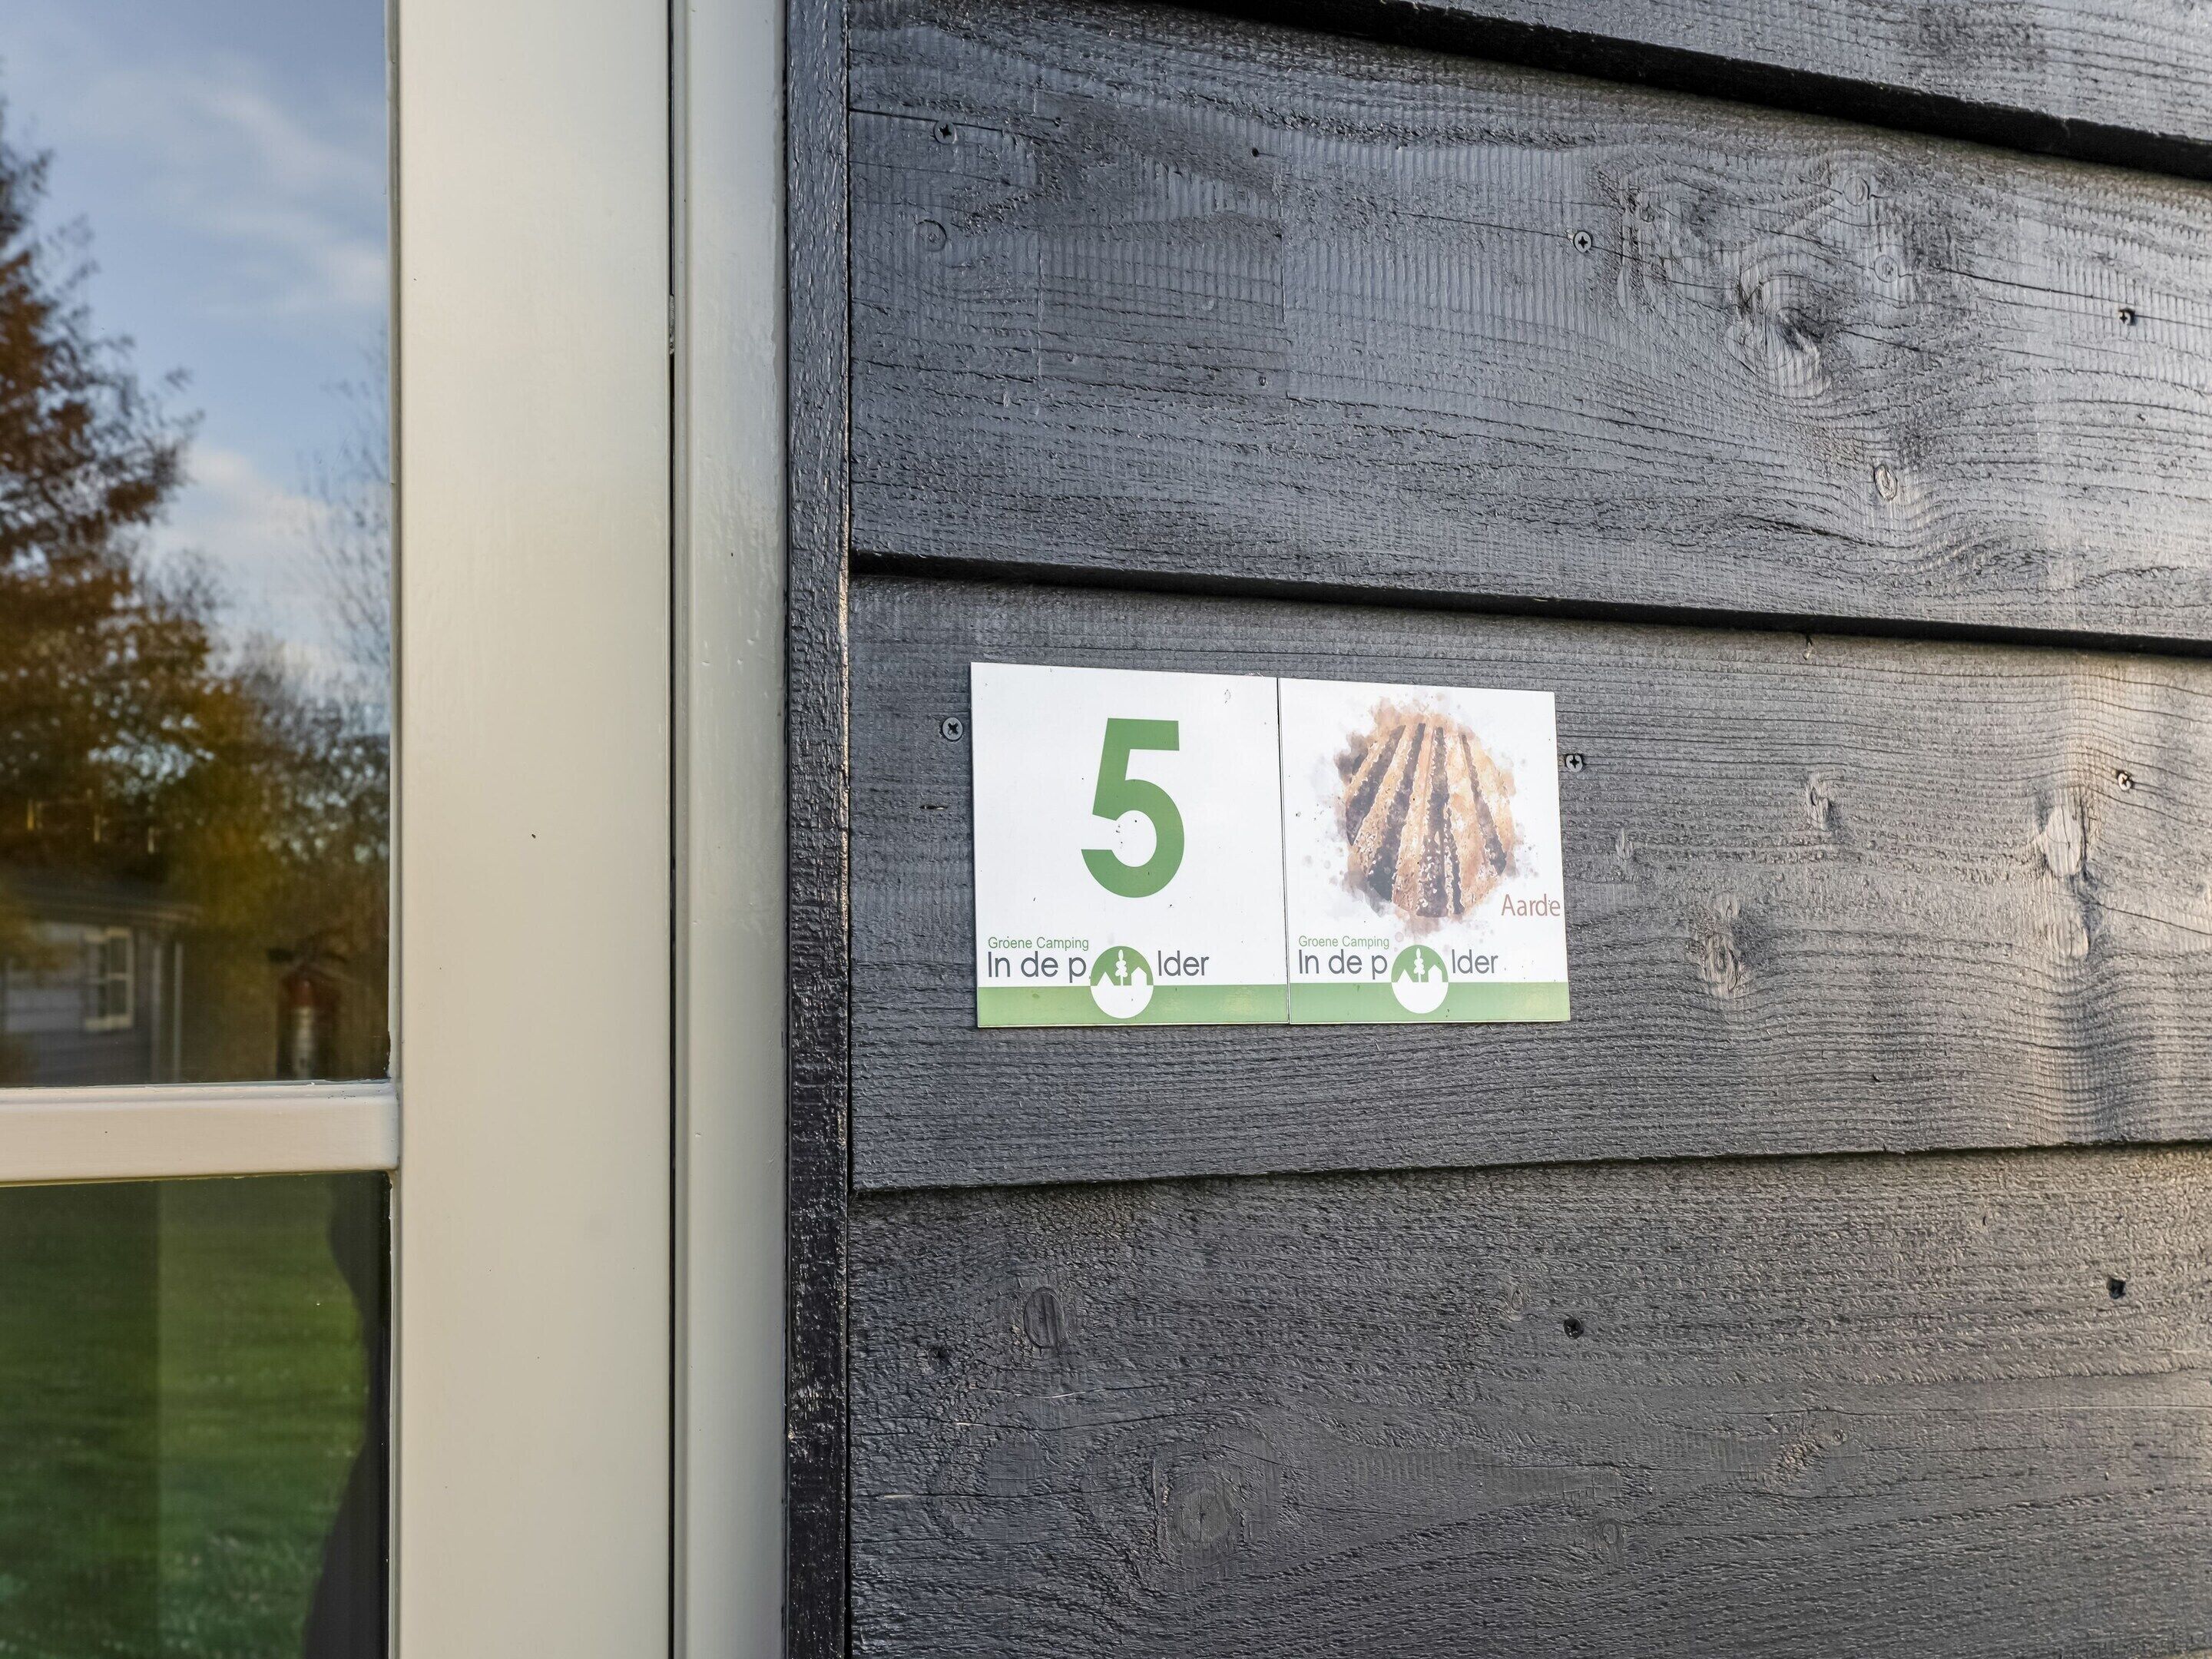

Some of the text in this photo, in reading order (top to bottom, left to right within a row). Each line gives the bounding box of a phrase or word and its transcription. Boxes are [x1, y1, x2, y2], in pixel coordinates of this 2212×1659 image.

[1081, 717, 1185, 898] 5
[1501, 893, 1561, 917] Aarde
[988, 936, 1089, 952] Groene Camping
[1298, 935, 1390, 949] Groene Camping
[988, 951, 1011, 979] In
[1020, 950, 1059, 978] de
[1298, 949, 1320, 975] In
[1327, 949, 1363, 975] de
